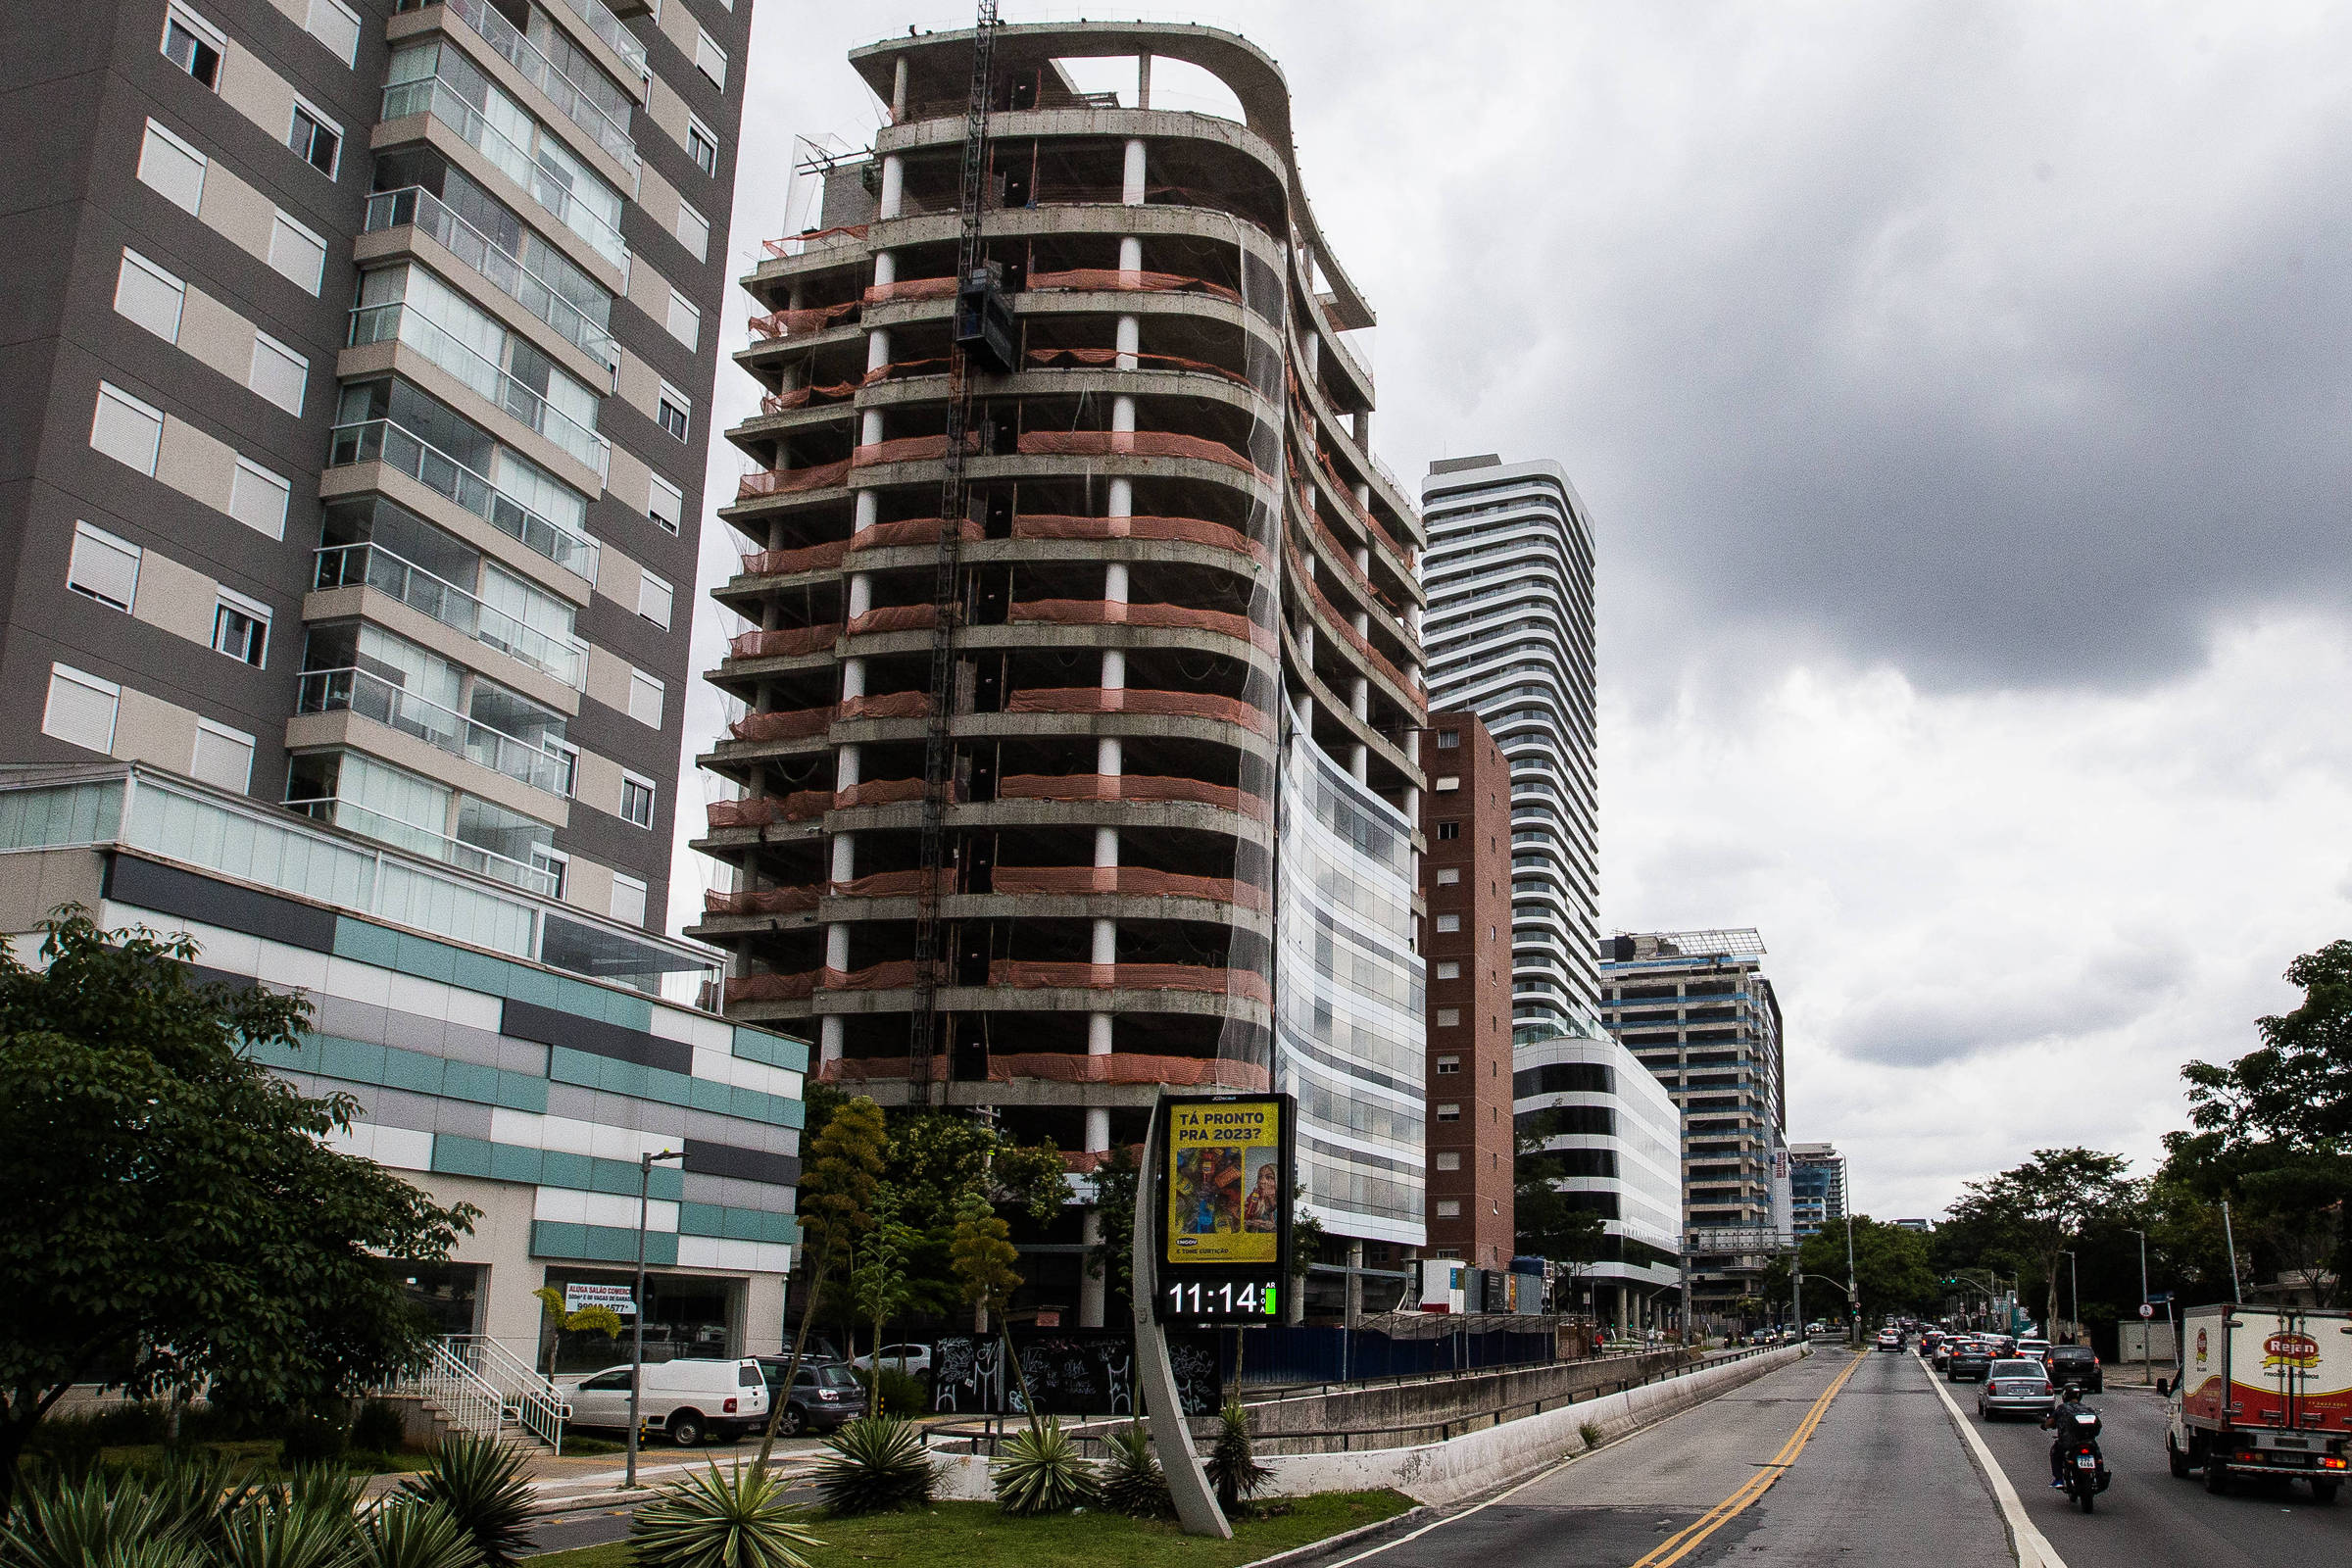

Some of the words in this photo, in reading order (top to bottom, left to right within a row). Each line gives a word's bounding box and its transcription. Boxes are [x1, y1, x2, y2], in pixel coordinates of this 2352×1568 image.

[1179, 1110, 1200, 1125] TÁ
[1204, 1112, 1265, 1125] PRONTO
[1179, 1129, 1209, 1142] PRA
[1214, 1128, 1262, 1140] 2023?
[589, 1286, 607, 1295] SALÃO
[1169, 1282, 1257, 1313] 11:14
[2270, 1340, 2315, 1354] Rejan
